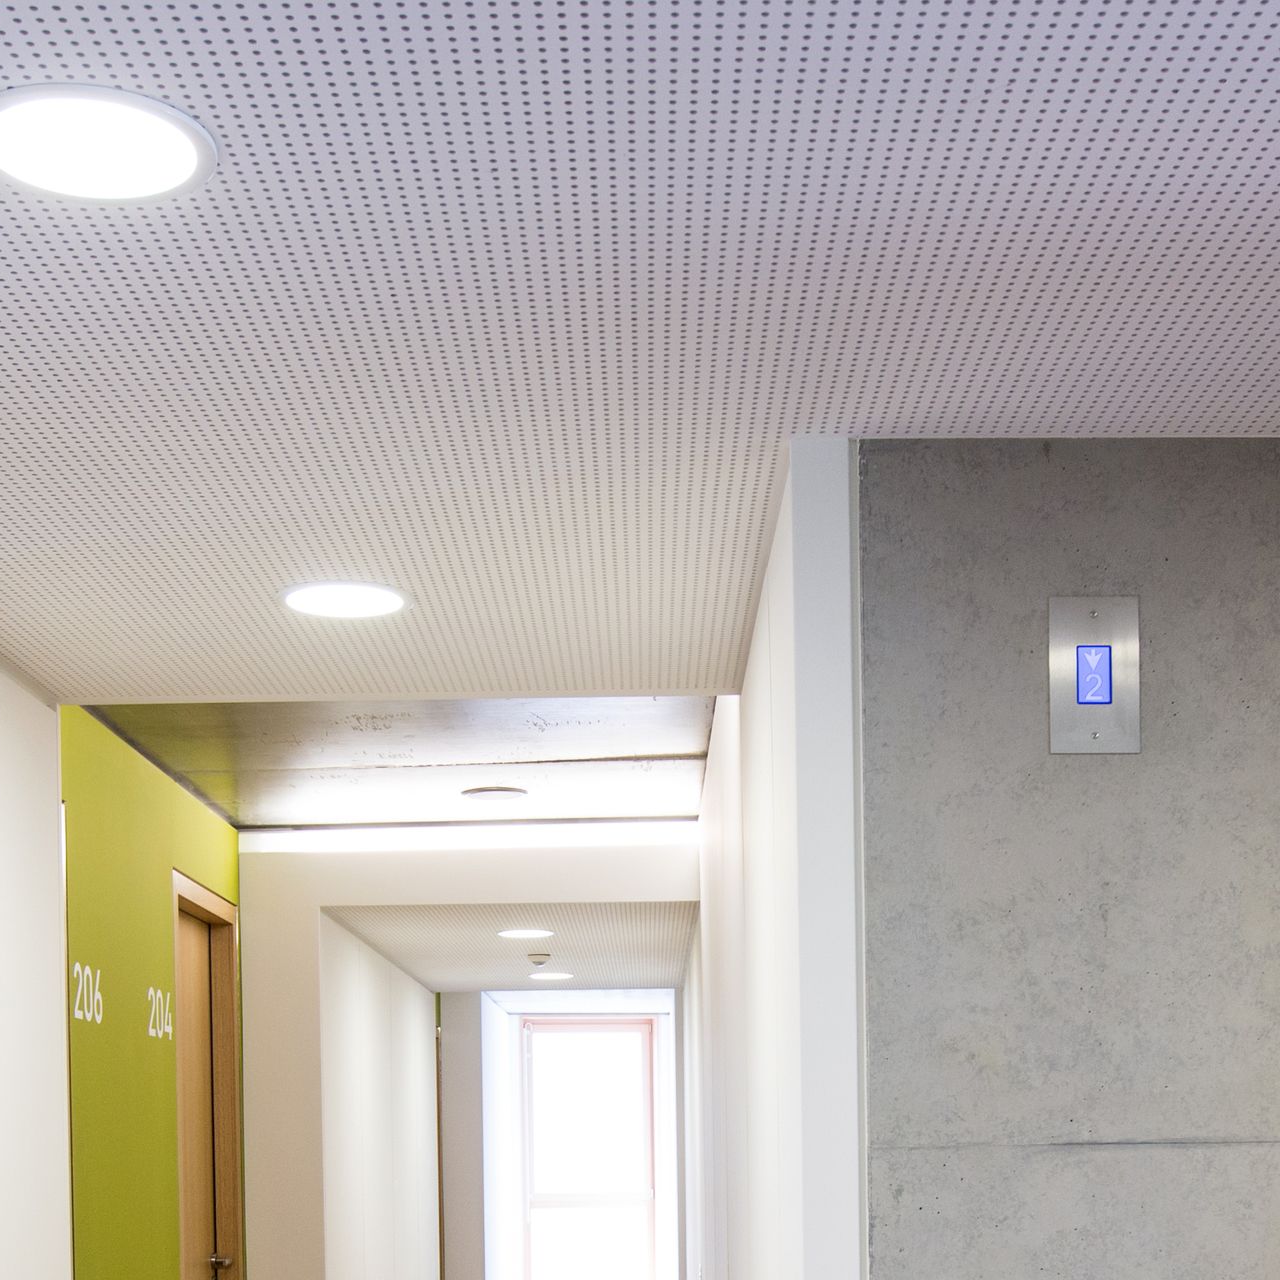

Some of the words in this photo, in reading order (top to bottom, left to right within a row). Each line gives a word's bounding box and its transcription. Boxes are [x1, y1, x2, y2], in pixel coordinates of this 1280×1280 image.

[1085, 673, 1104, 701] 2
[72, 960, 104, 1025] 206
[146, 986, 173, 1041] 204
